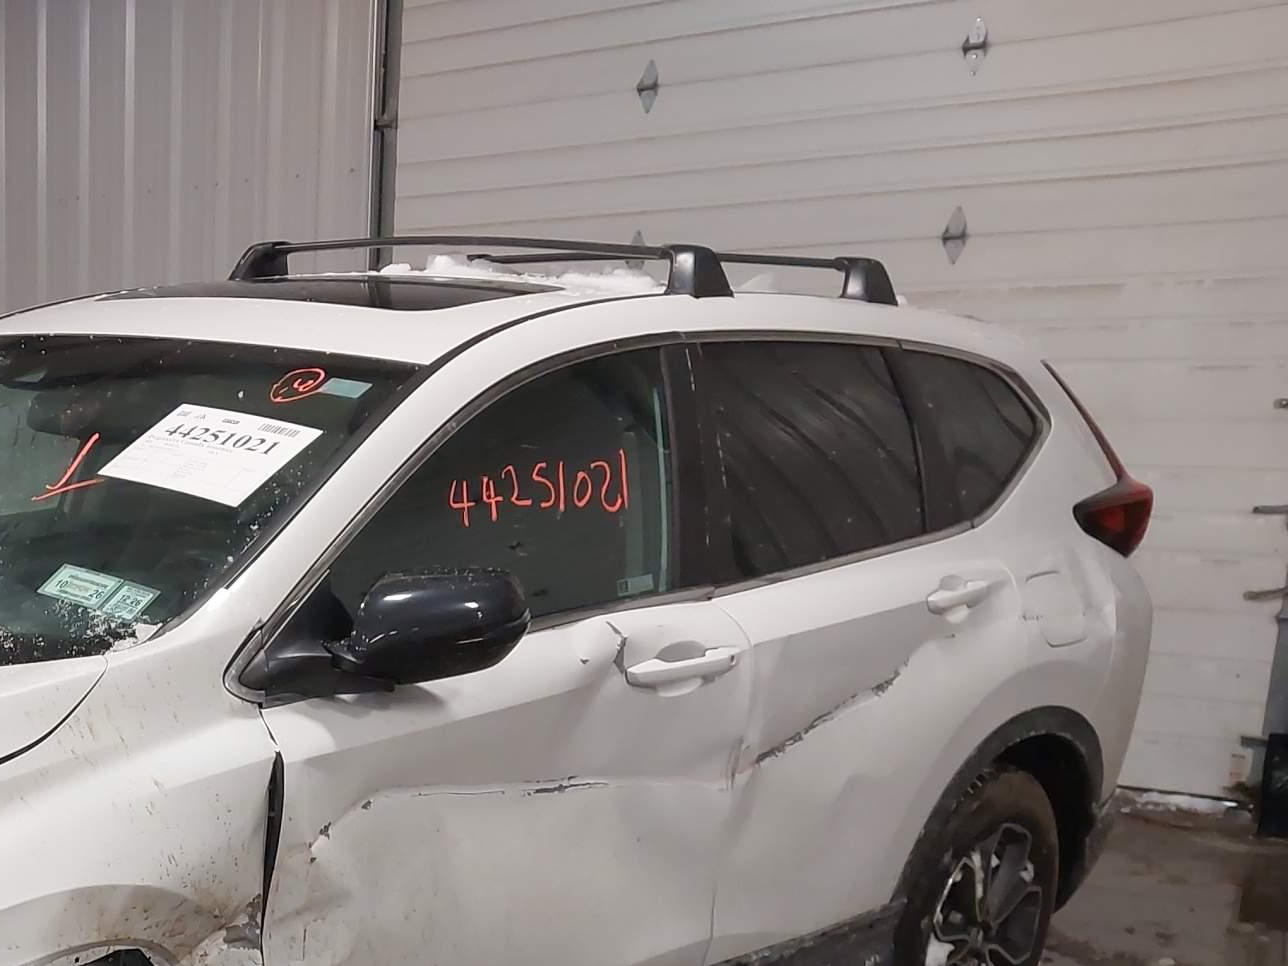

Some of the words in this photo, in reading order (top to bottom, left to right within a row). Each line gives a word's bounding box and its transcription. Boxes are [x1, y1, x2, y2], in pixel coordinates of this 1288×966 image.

[165, 423, 281, 455] 44251021
[448, 448, 629, 528] 44251021
[88, 589, 105, 600] 26
[130, 597, 144, 607] 26
